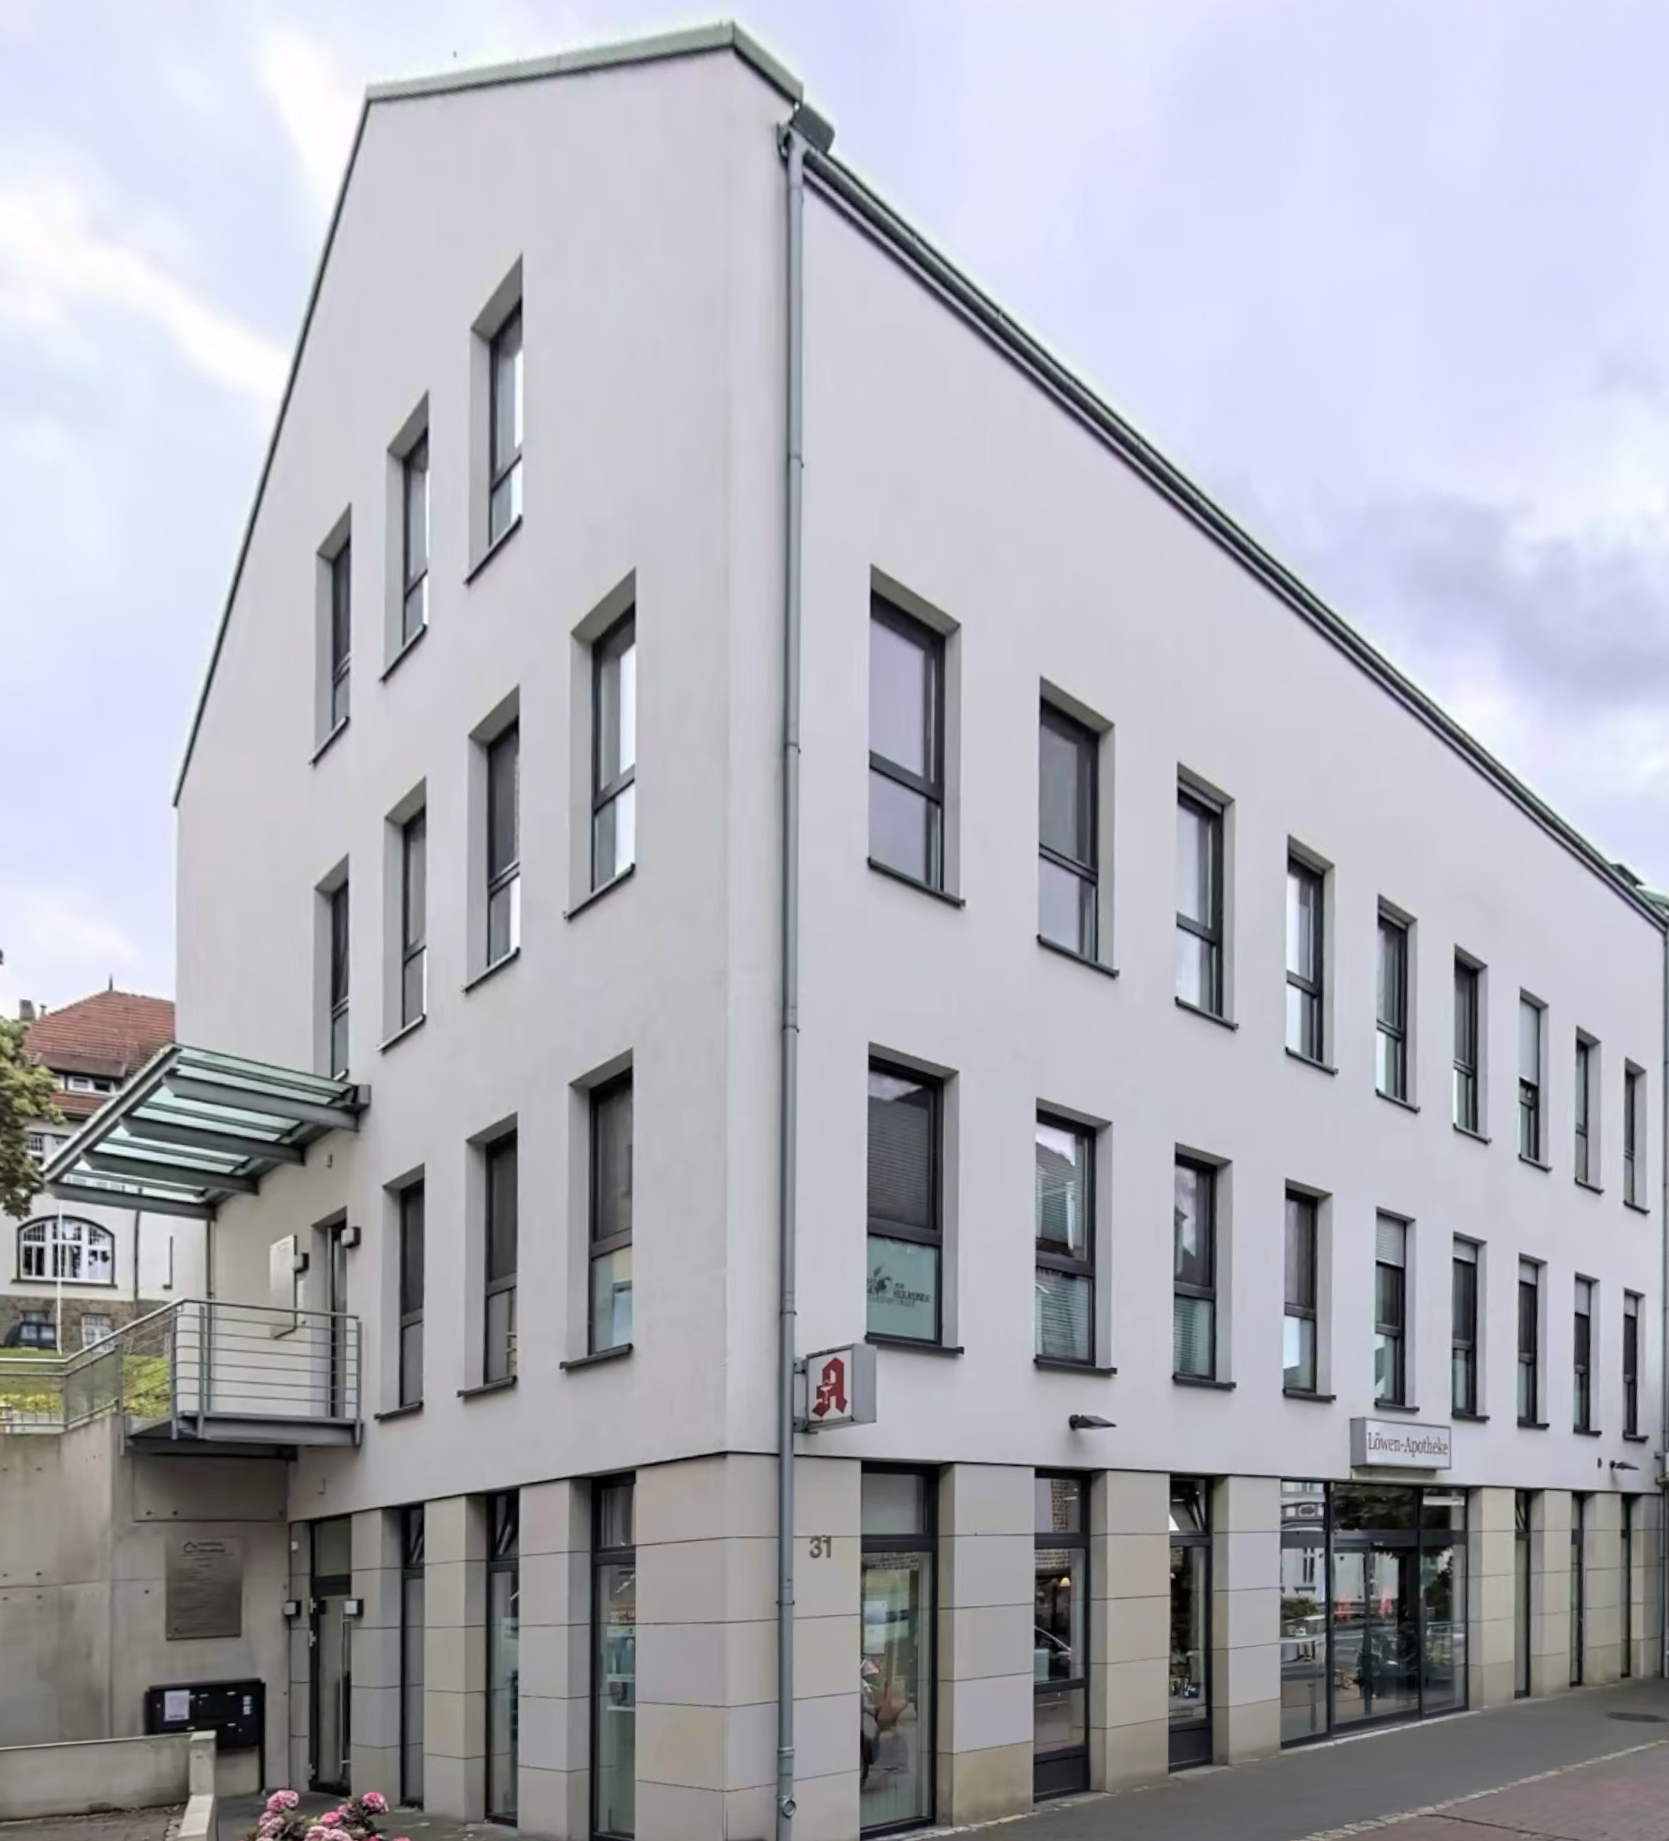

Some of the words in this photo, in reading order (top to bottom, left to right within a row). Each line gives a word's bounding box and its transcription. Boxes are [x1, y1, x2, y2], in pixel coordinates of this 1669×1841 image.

[811, 1357, 848, 1417] A
[1368, 1432, 1449, 1458] Löwen-Apotheke
[809, 1535, 831, 1558] 31
